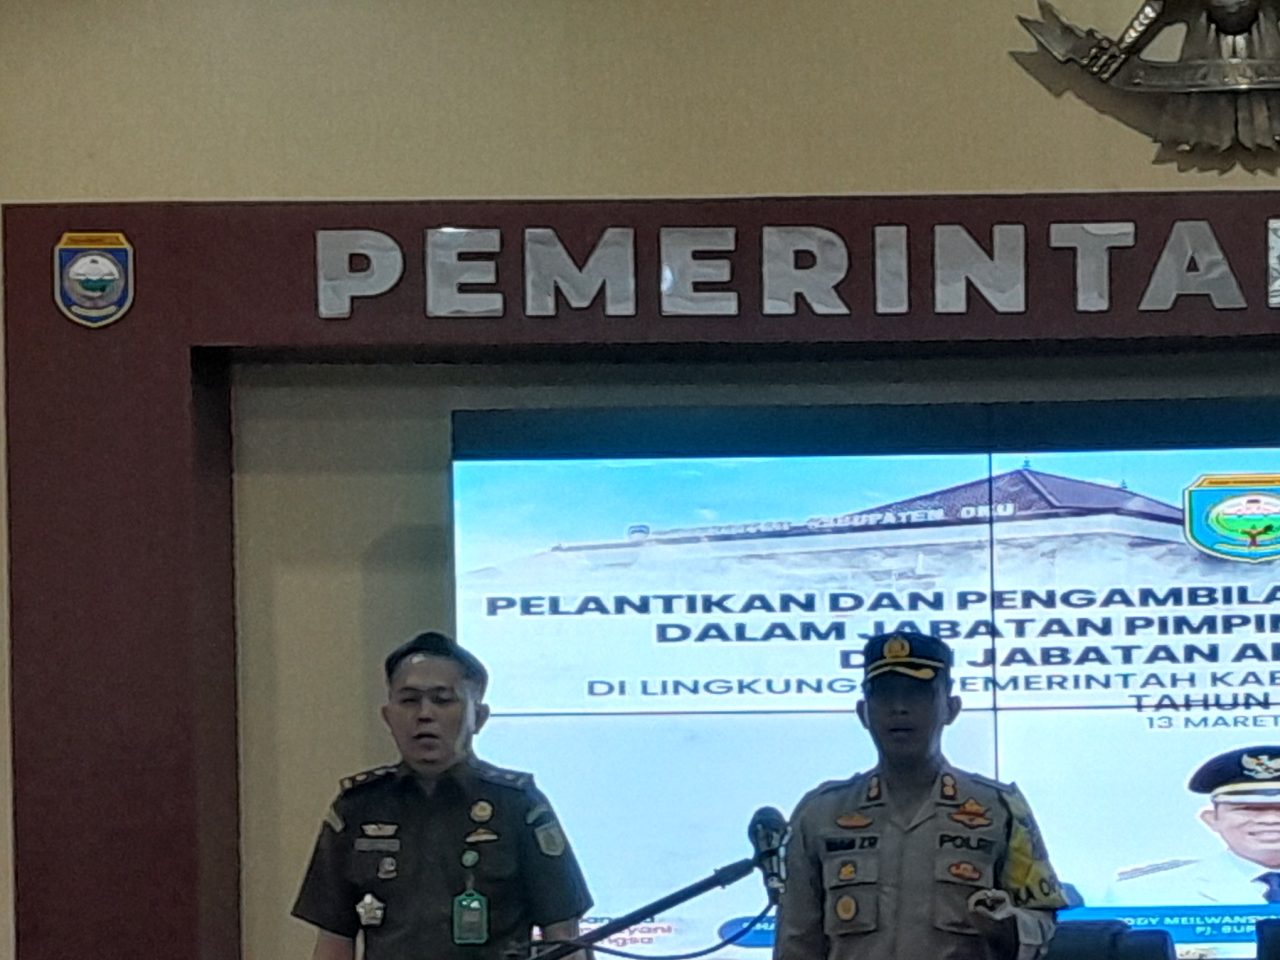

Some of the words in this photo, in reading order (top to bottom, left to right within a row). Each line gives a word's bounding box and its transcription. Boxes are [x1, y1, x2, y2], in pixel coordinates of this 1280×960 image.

[486, 593, 816, 617] PELANTIKAN
[828, 590, 944, 613] DAN
[656, 620, 846, 643] DALAM
[966, 643, 1220, 668] JABATAN
[587, 680, 627, 696] DI
[641, 677, 862, 696] LINGKUNG
[953, 671, 1196, 693] EMERINTAH
[1129, 693, 1271, 712] TAHUN
[1147, 716, 1173, 729] 13
